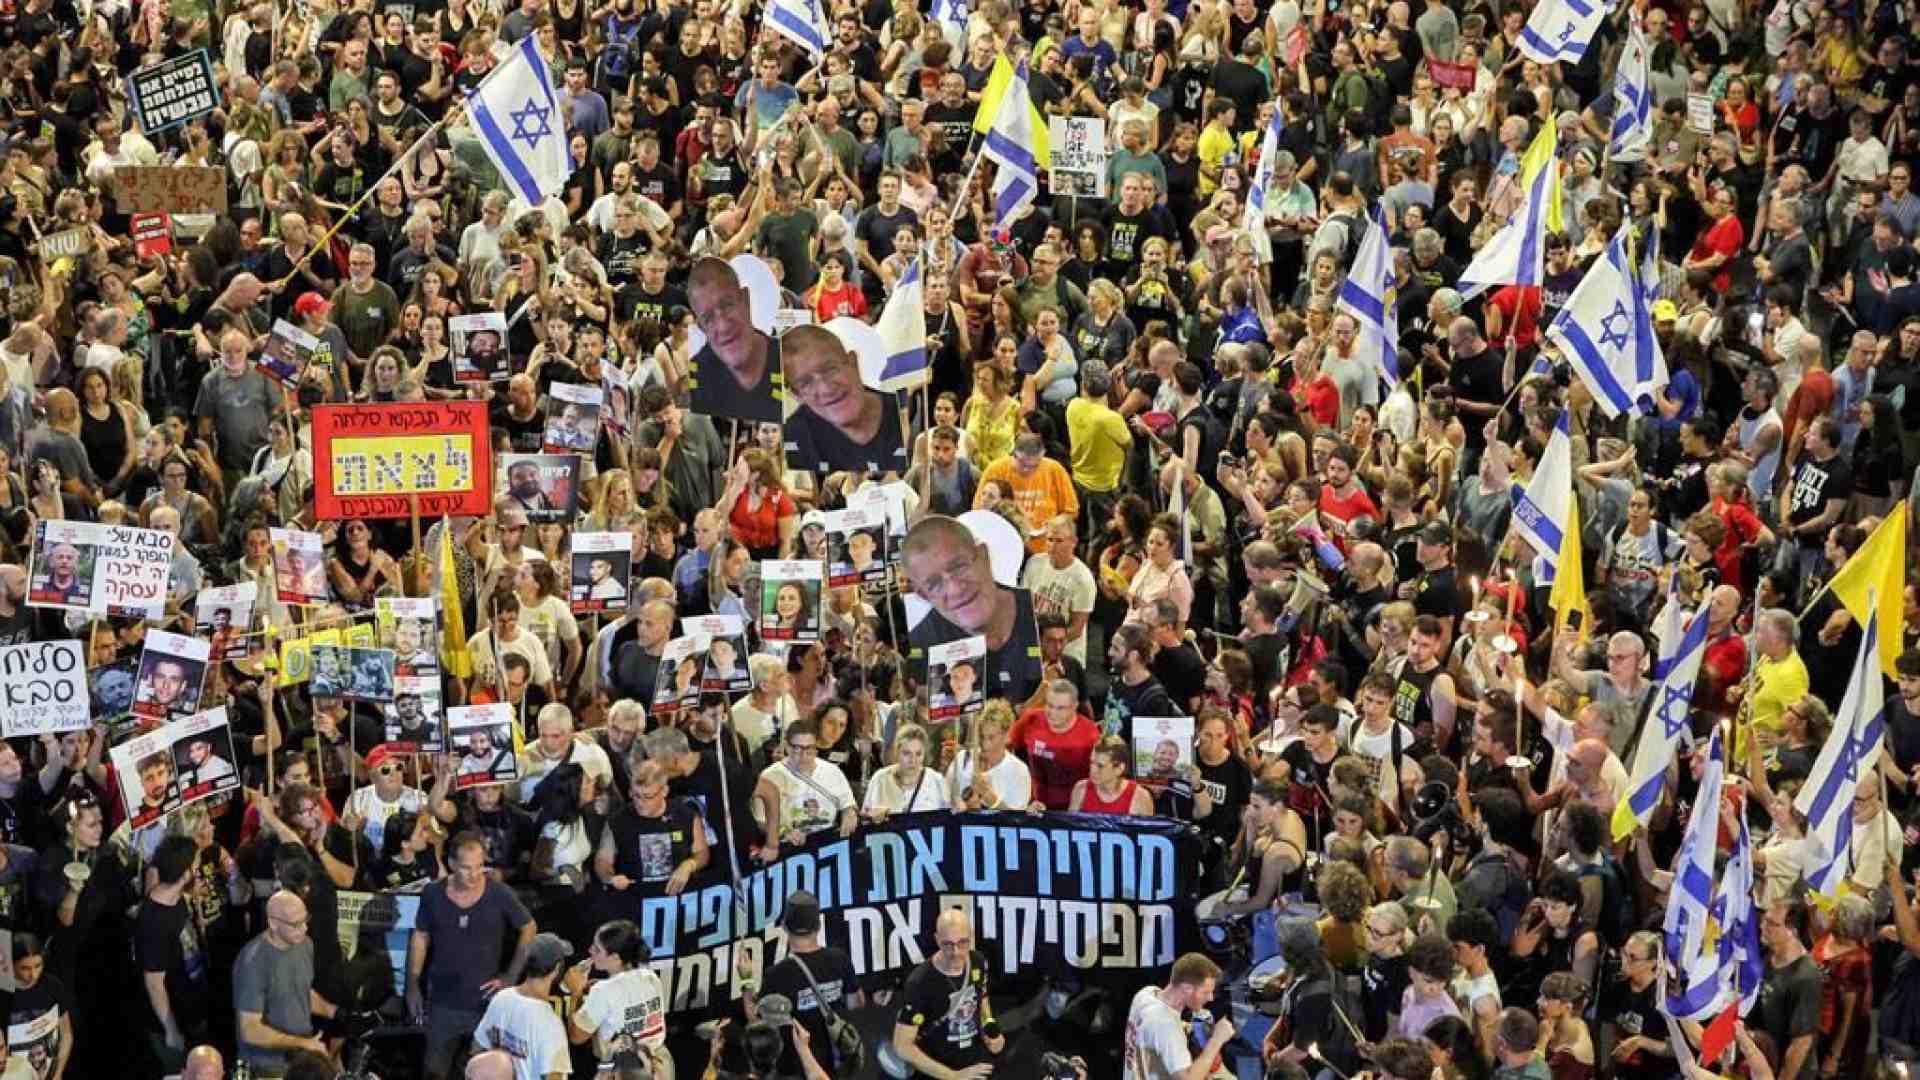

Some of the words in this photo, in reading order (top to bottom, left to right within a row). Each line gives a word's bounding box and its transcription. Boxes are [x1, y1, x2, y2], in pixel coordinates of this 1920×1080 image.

[446, 404, 472, 425] אל
[136, 532, 172, 549] סבא
[105, 578, 158, 602] עסקה
[4, 678, 74, 707] סבא
[865, 826, 949, 903] את
[960, 825, 1175, 902] מחזירים
[647, 912, 828, 1014] לחימה
[843, 898, 925, 976] את
